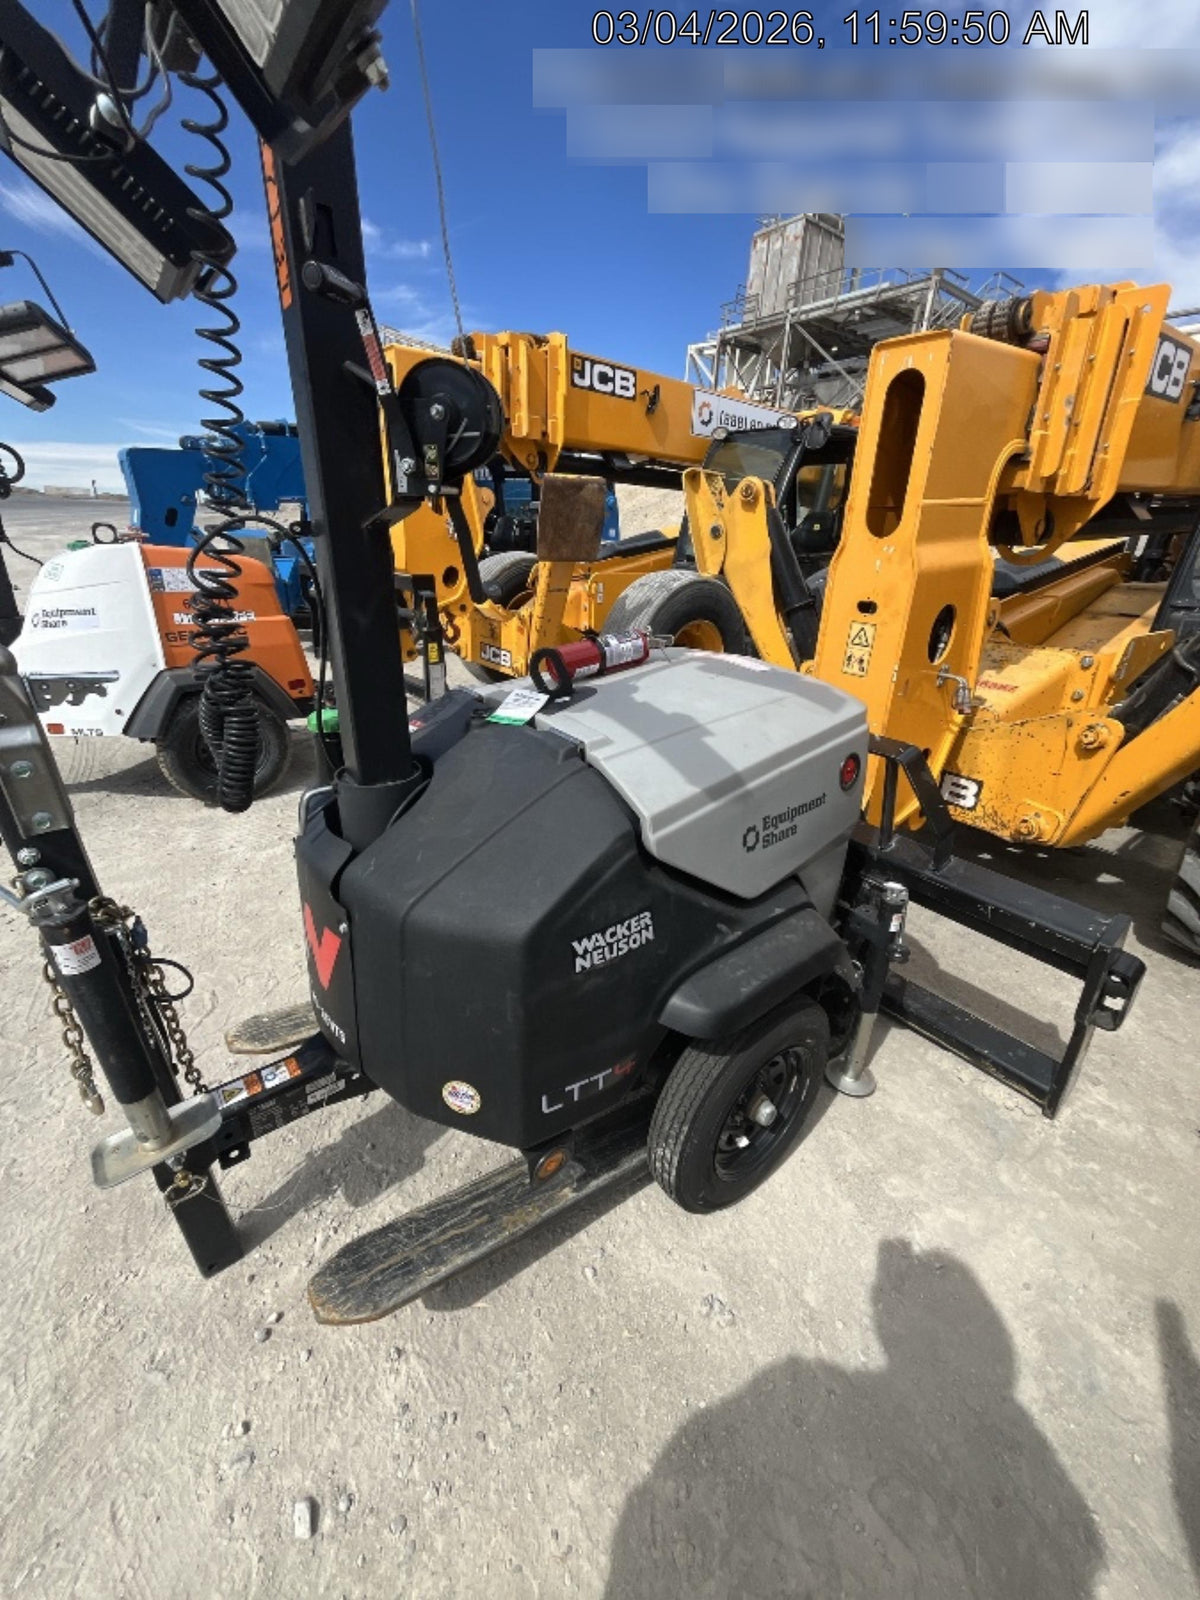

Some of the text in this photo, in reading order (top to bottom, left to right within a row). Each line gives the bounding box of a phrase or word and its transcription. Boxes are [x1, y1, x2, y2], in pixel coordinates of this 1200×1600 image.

[573, 359, 636, 398] JCB
[1151, 340, 1191, 399] CB
[481, 643, 512, 668] JCB
[761, 791, 827, 833] Equipment
[762, 824, 798, 850] Share
[570, 911, 653, 956] WACKER
[574, 926, 655, 974] NEUSON
